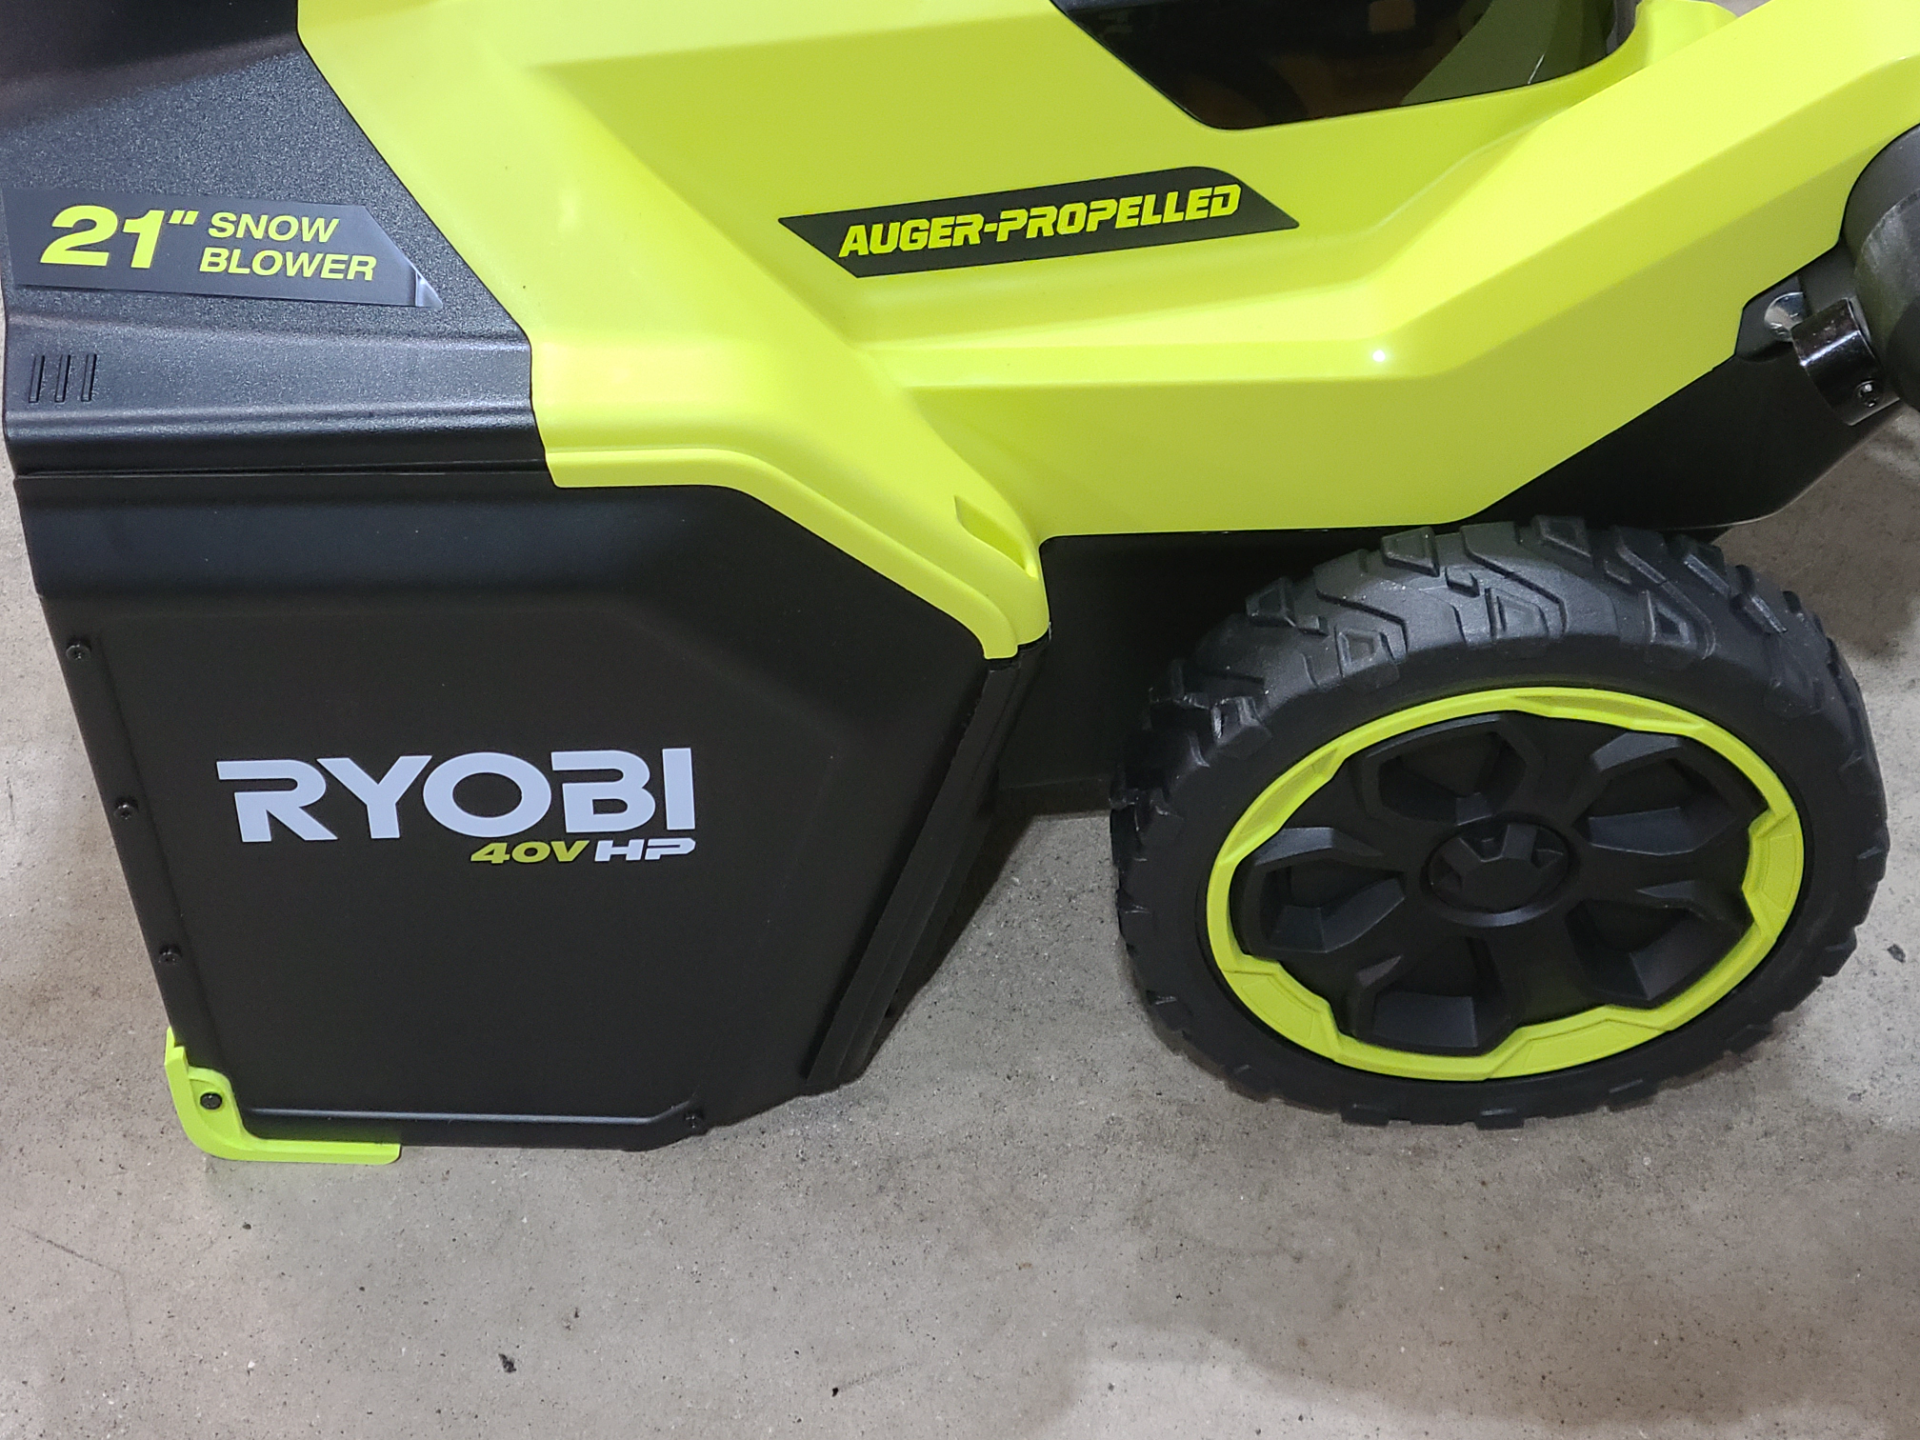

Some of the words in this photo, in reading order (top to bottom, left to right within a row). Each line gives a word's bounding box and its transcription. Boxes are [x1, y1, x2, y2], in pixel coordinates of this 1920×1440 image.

[40, 205, 198, 268] 21"
[208, 211, 339, 243] SNOW
[839, 184, 1241, 257] AUGER-PROPELLED
[199, 247, 377, 281] BLOWER
[216, 747, 696, 842] RYOBI
